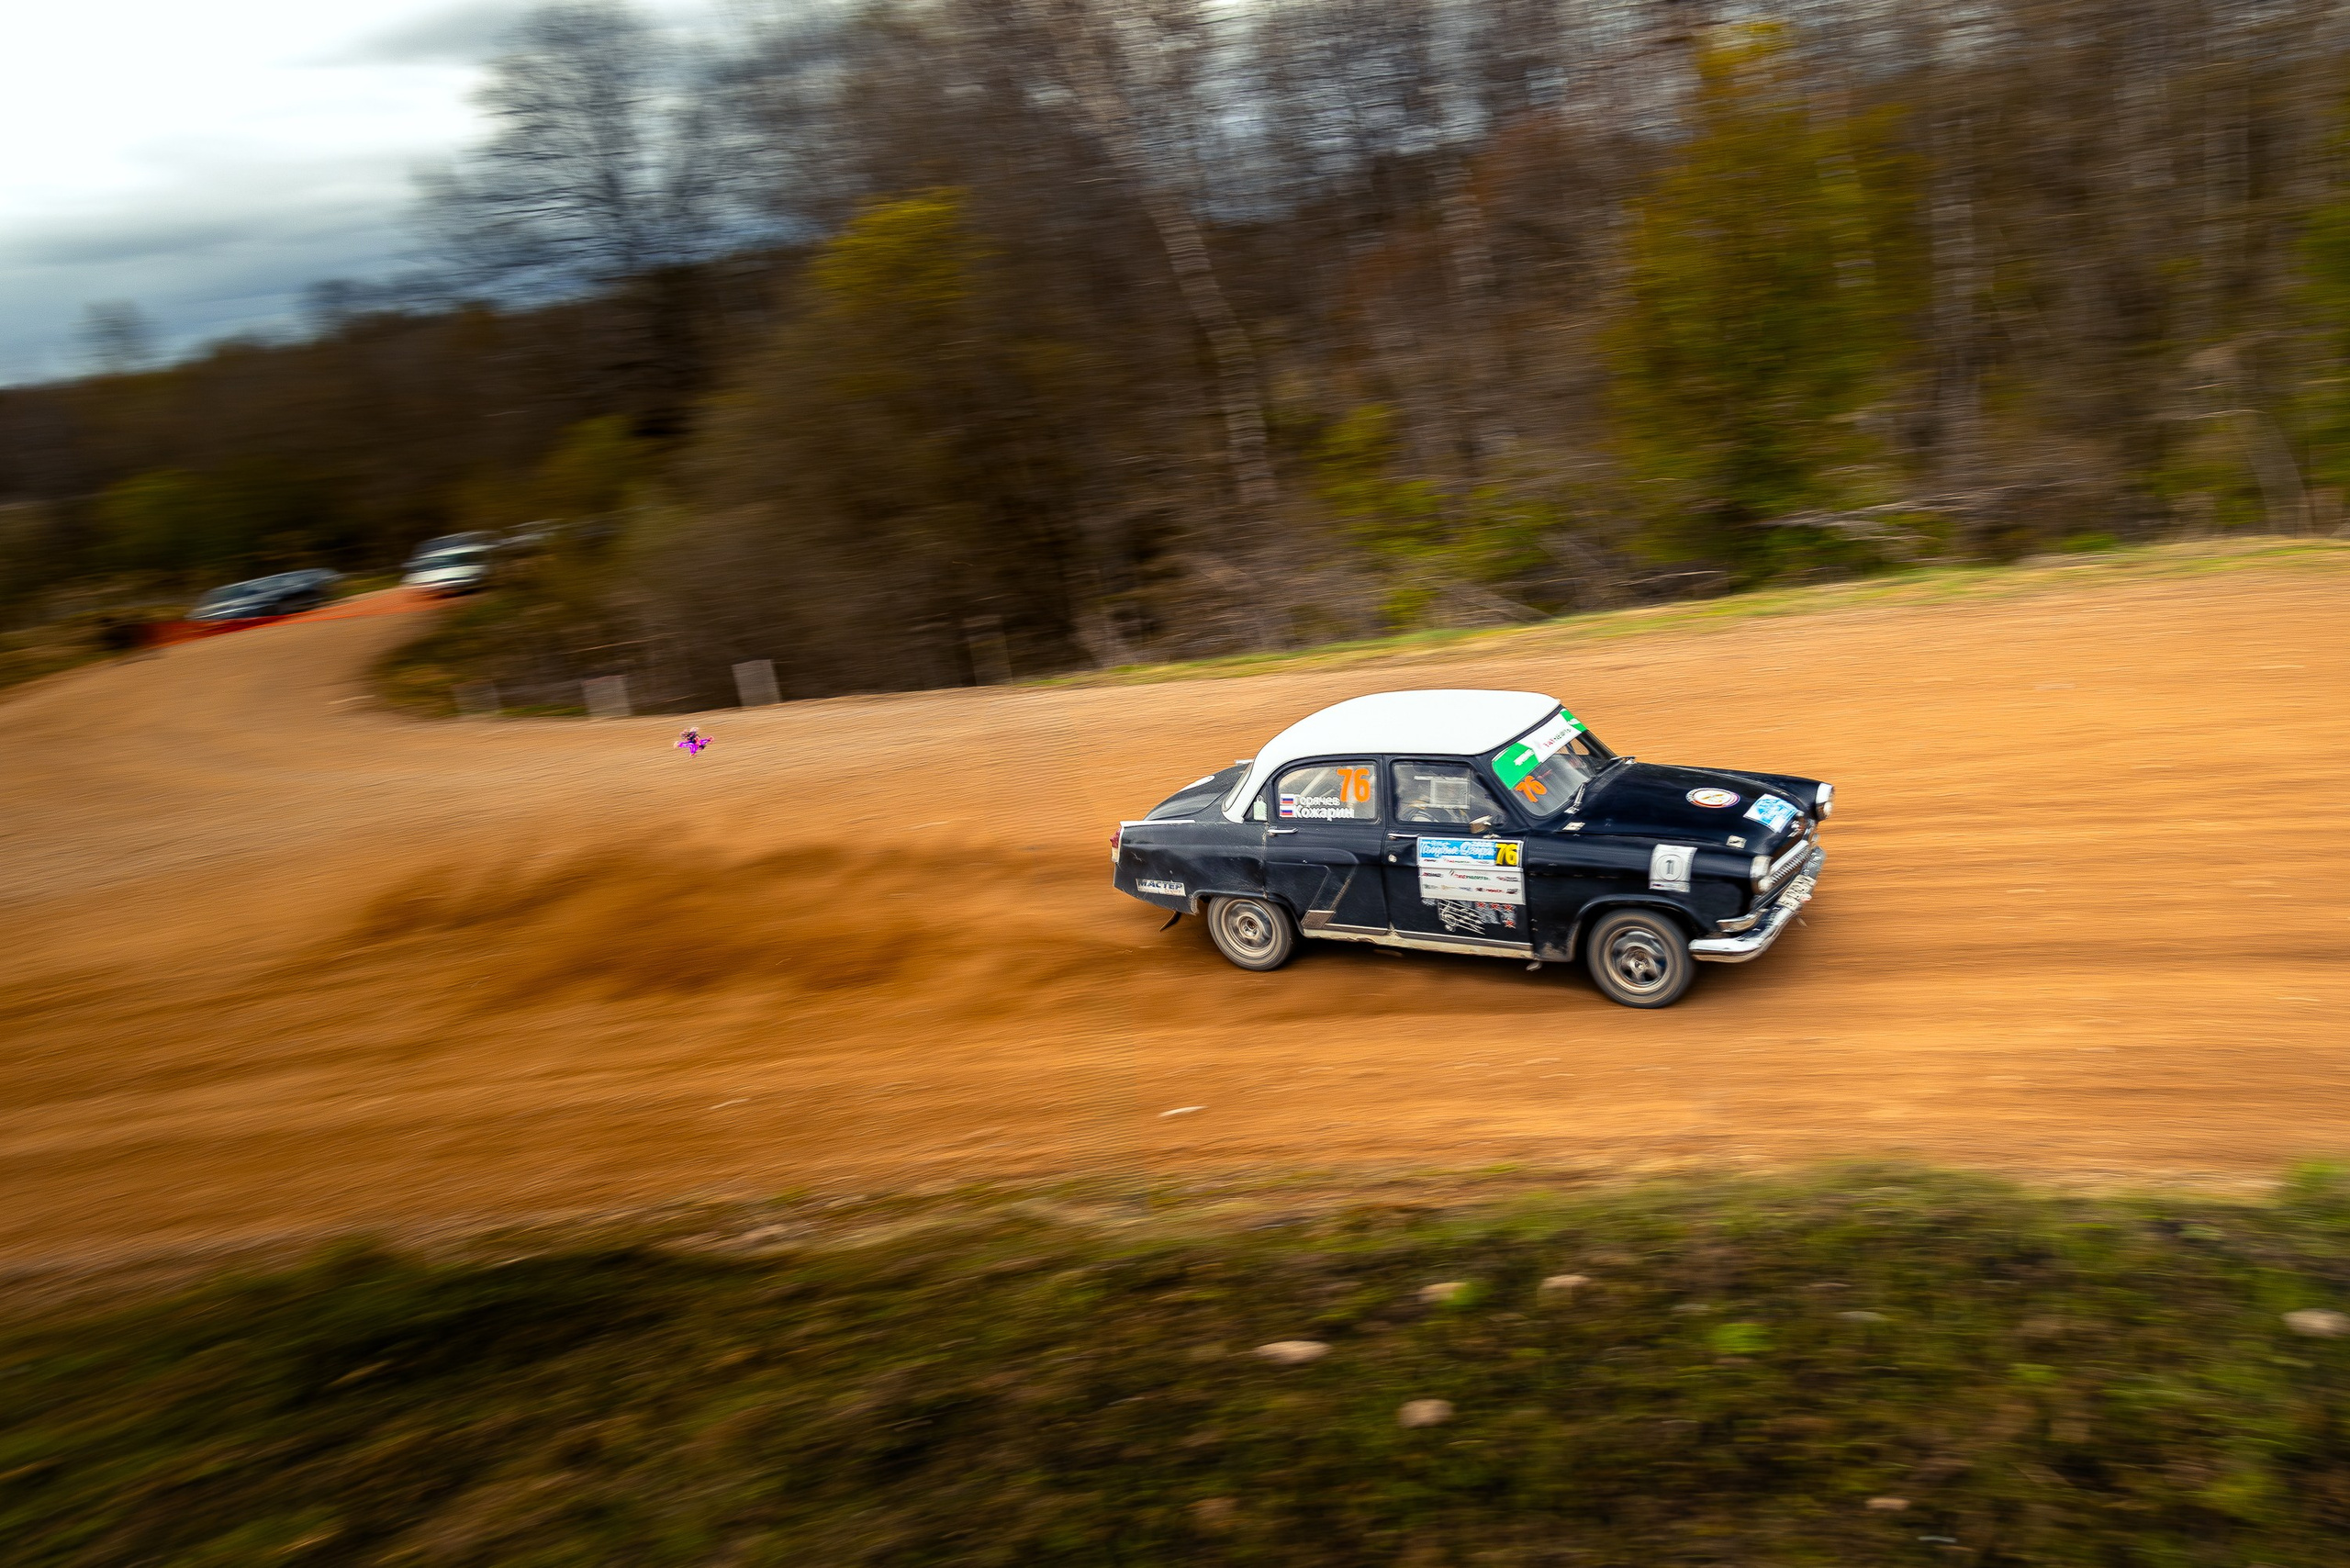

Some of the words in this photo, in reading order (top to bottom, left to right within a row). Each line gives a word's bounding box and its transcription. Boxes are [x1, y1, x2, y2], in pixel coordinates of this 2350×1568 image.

[1337, 767, 1371, 803] 76
[1515, 775, 1548, 803] 76
[1294, 794, 1341, 808] Горячев
[1495, 843, 1519, 866] 76
[1138, 879, 1184, 890] МАСТЕР
